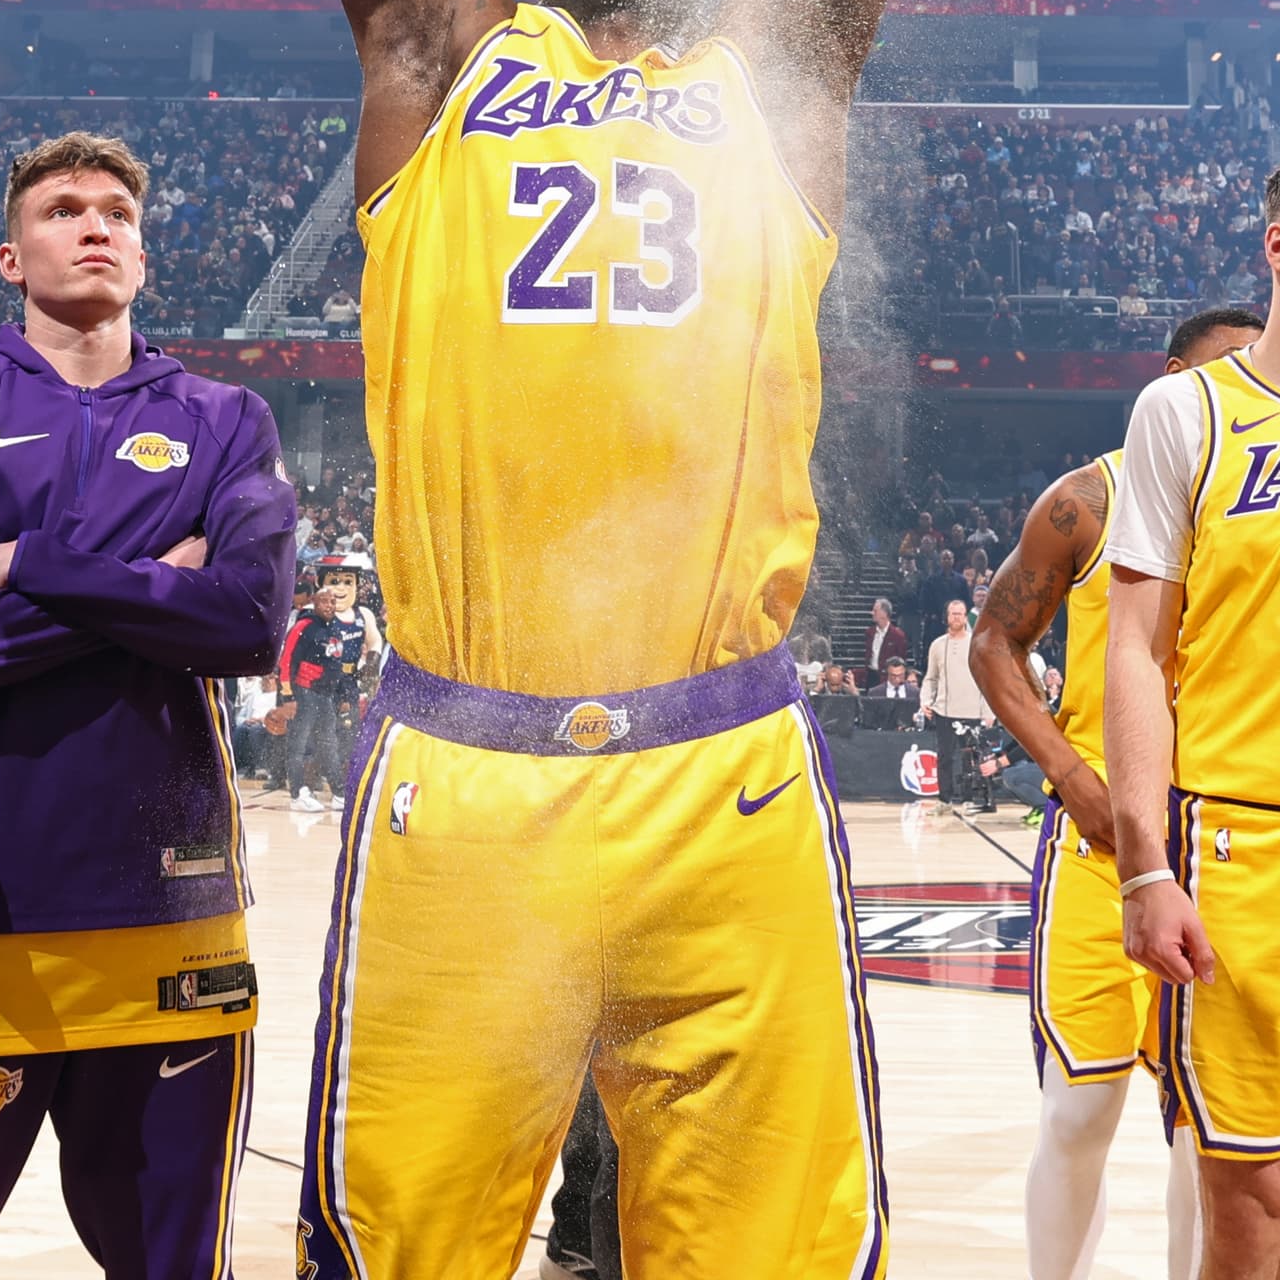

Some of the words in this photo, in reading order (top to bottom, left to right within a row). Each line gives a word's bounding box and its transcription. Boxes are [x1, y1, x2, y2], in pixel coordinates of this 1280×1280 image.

[460, 56, 729, 146] LAKERS
[501, 158, 704, 328] 23
[285, 327, 329, 340] Huntington
[116, 438, 188, 466] LAKERS
[553, 713, 631, 740] LAKERS
[182, 951, 213, 963] LEAVE
[220, 947, 246, 959] LEGACY
